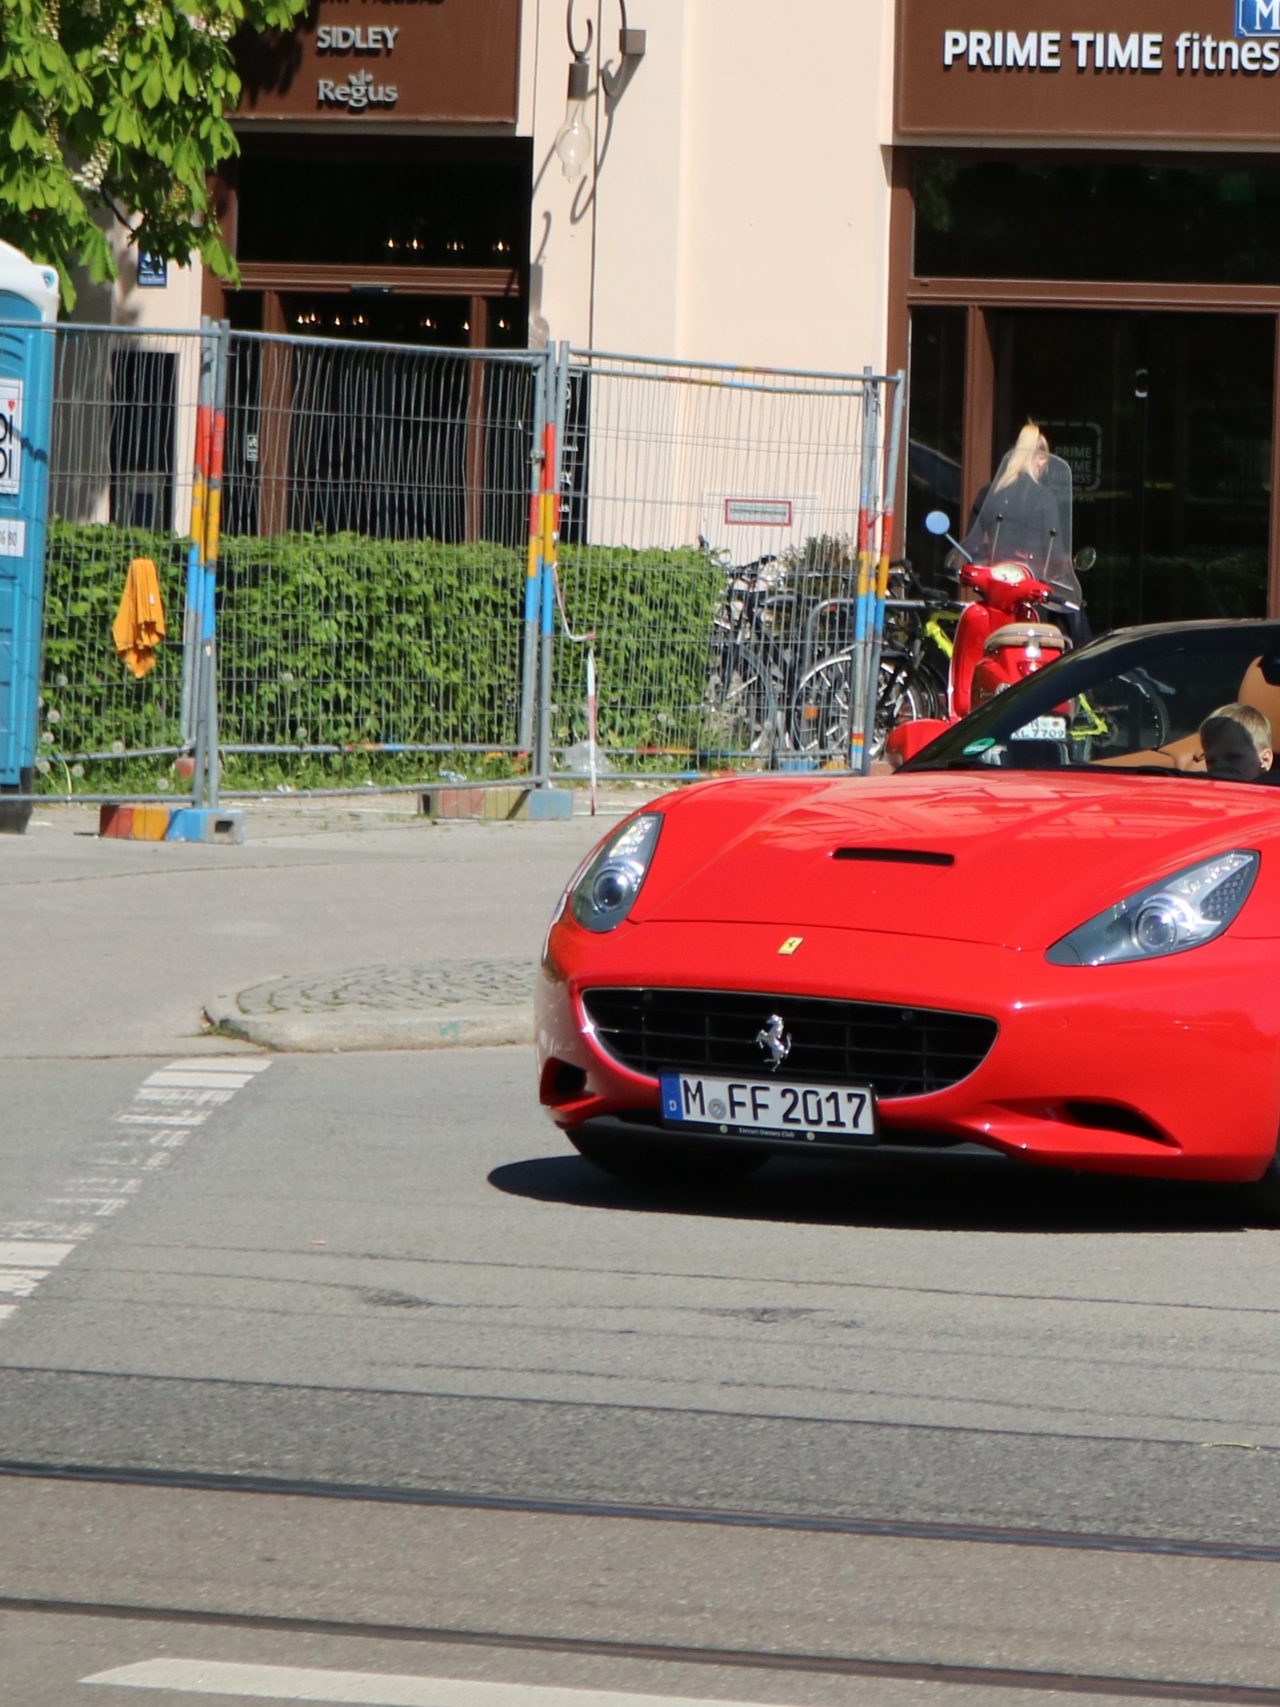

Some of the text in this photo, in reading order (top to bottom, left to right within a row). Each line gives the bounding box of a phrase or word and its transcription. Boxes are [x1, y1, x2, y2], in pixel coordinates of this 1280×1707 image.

[316, 26, 399, 49] SIDLEY
[942, 30, 1061, 66] PRIME
[1071, 32, 1163, 69] TIME
[317, 78, 399, 107] Regus
[669, 1101, 677, 1111] D
[682, 1079, 867, 1129] M FF 2017
[739, 1127, 758, 1135] Ferrari
